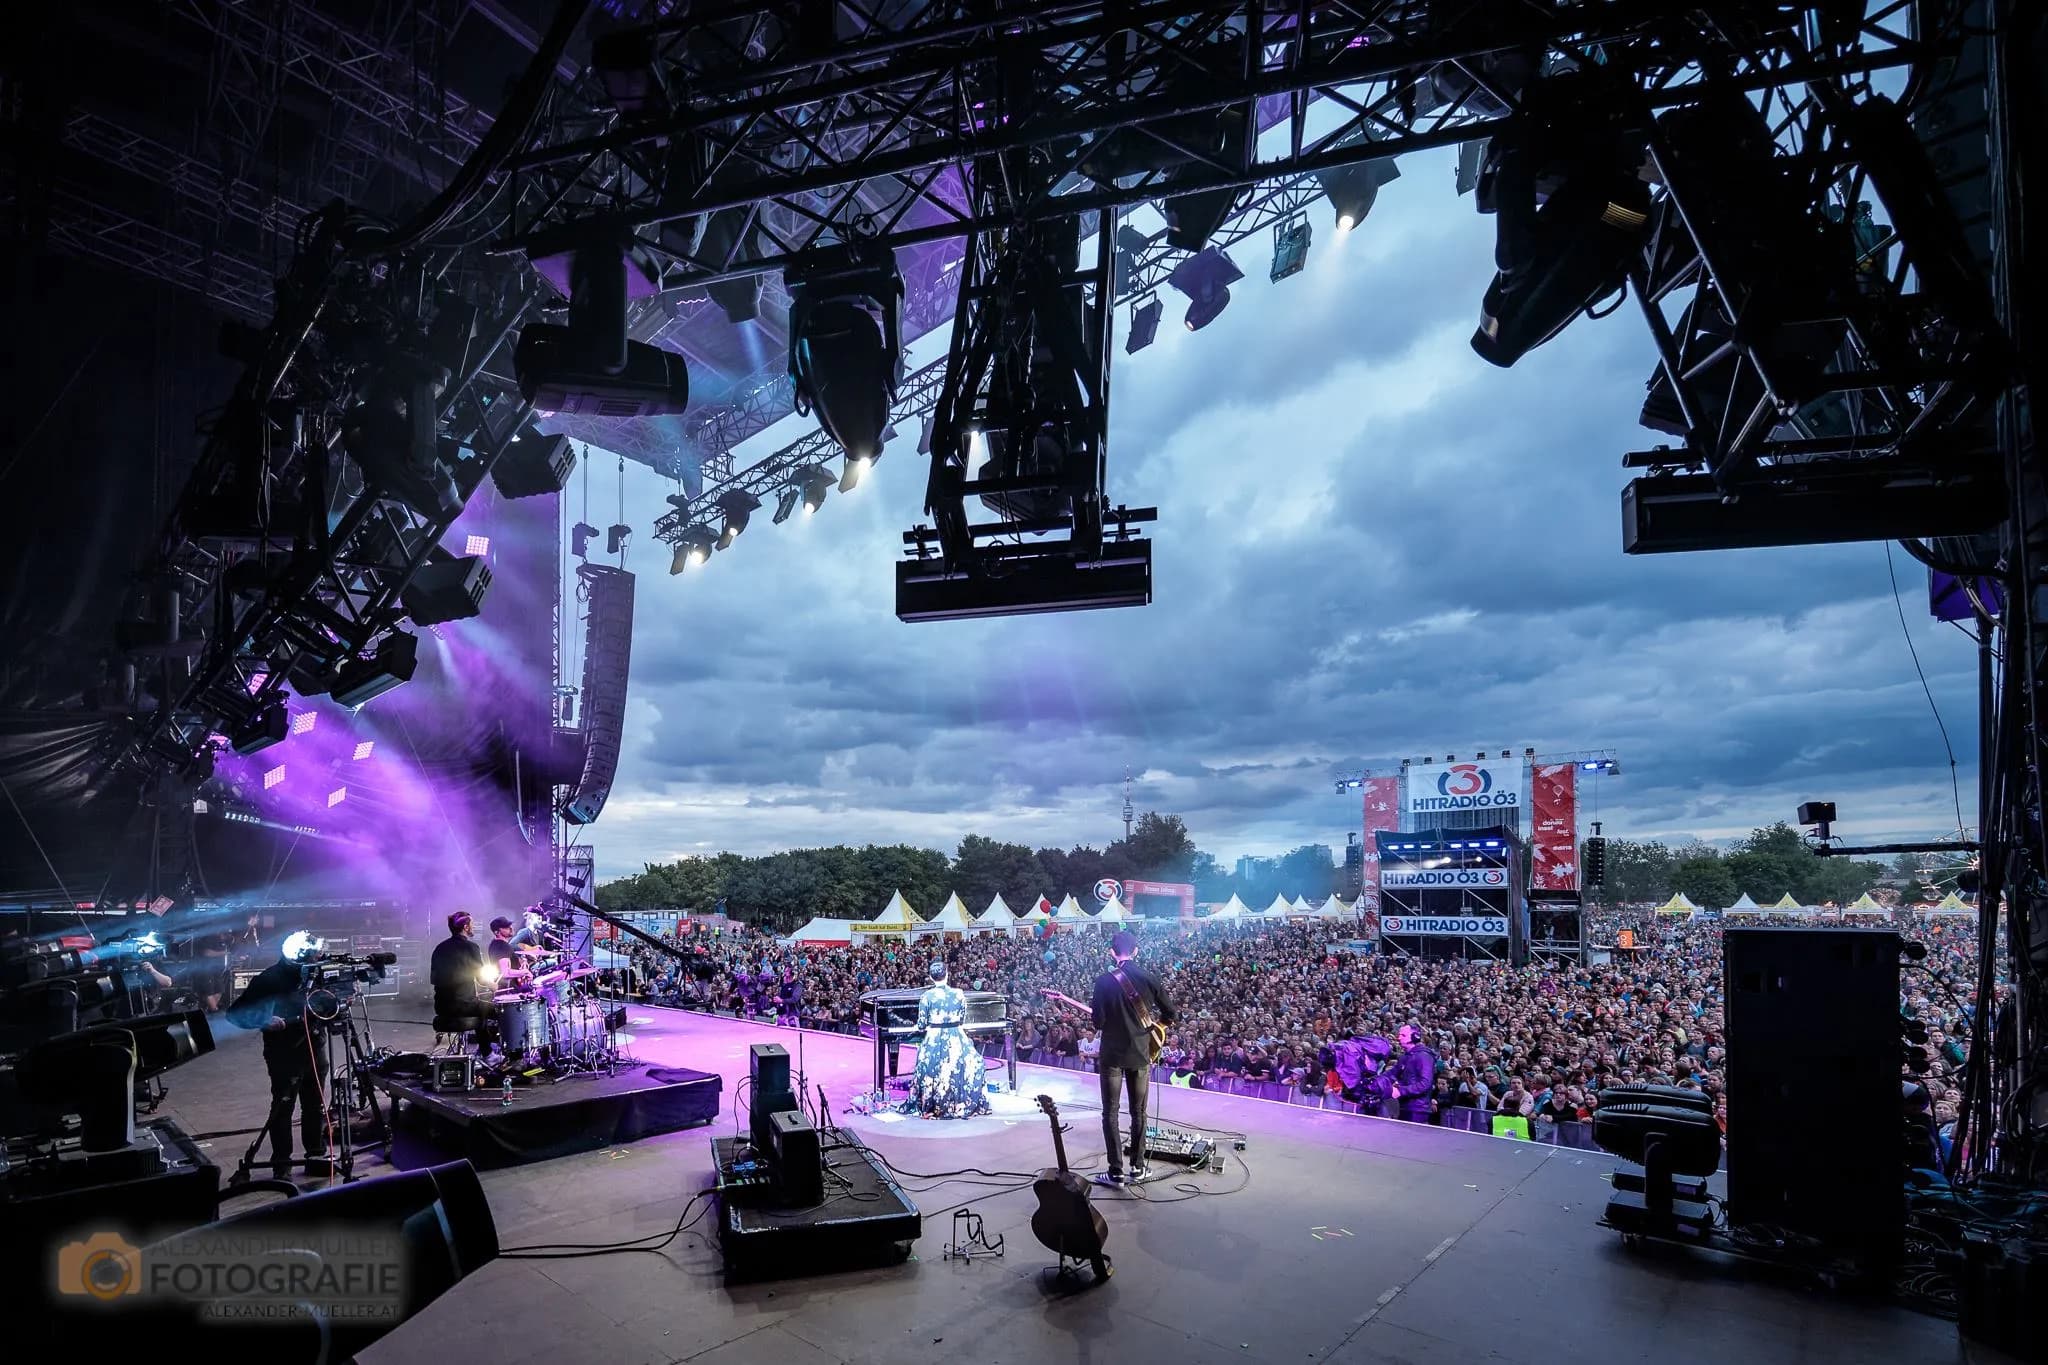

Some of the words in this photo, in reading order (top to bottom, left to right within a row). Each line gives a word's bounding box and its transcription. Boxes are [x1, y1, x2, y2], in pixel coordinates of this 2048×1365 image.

[1413, 796, 1490, 811] HITRADIO
[1494, 790, 1517, 806] Ö3
[1383, 872, 1454, 885] HITRADIO
[1457, 868, 1480, 884] Ö3
[1406, 920, 1478, 932] HITRADIO
[1482, 918, 1505, 932] Ö3
